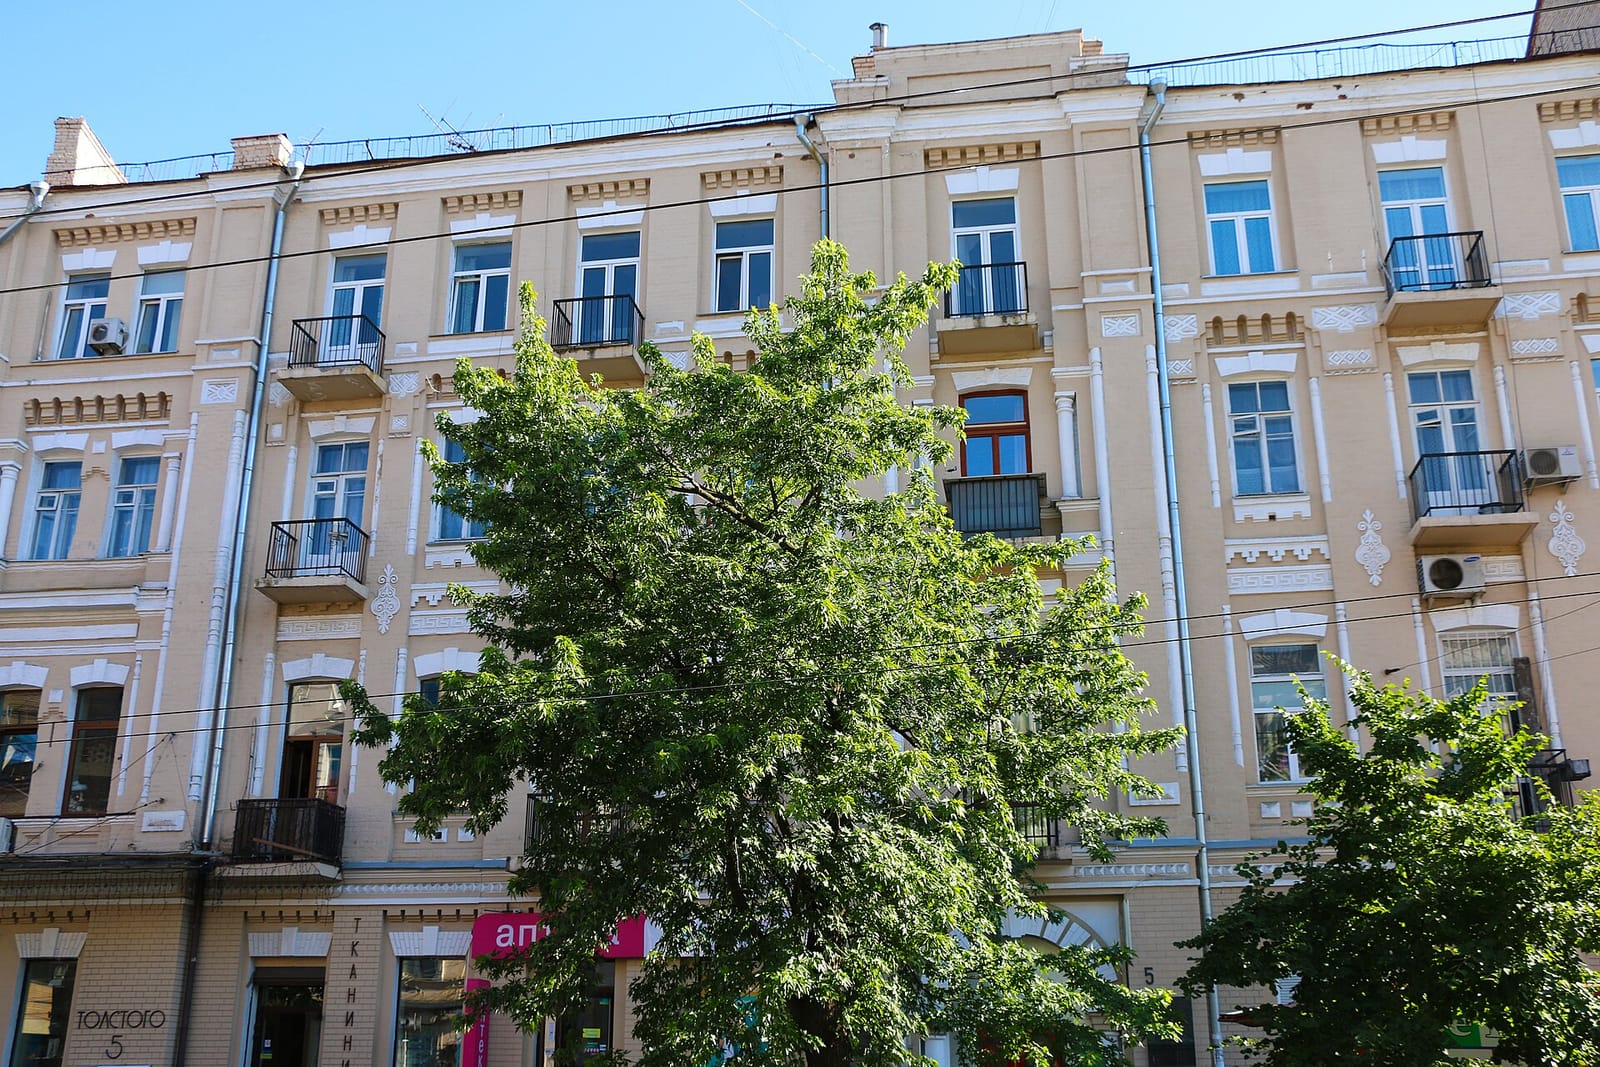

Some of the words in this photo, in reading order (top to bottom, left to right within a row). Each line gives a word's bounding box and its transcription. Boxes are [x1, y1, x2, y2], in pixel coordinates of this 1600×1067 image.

[1143, 966, 1154, 986] 5
[77, 1010, 166, 1029] ТОЛСТОГО
[105, 1035, 123, 1060] 5
